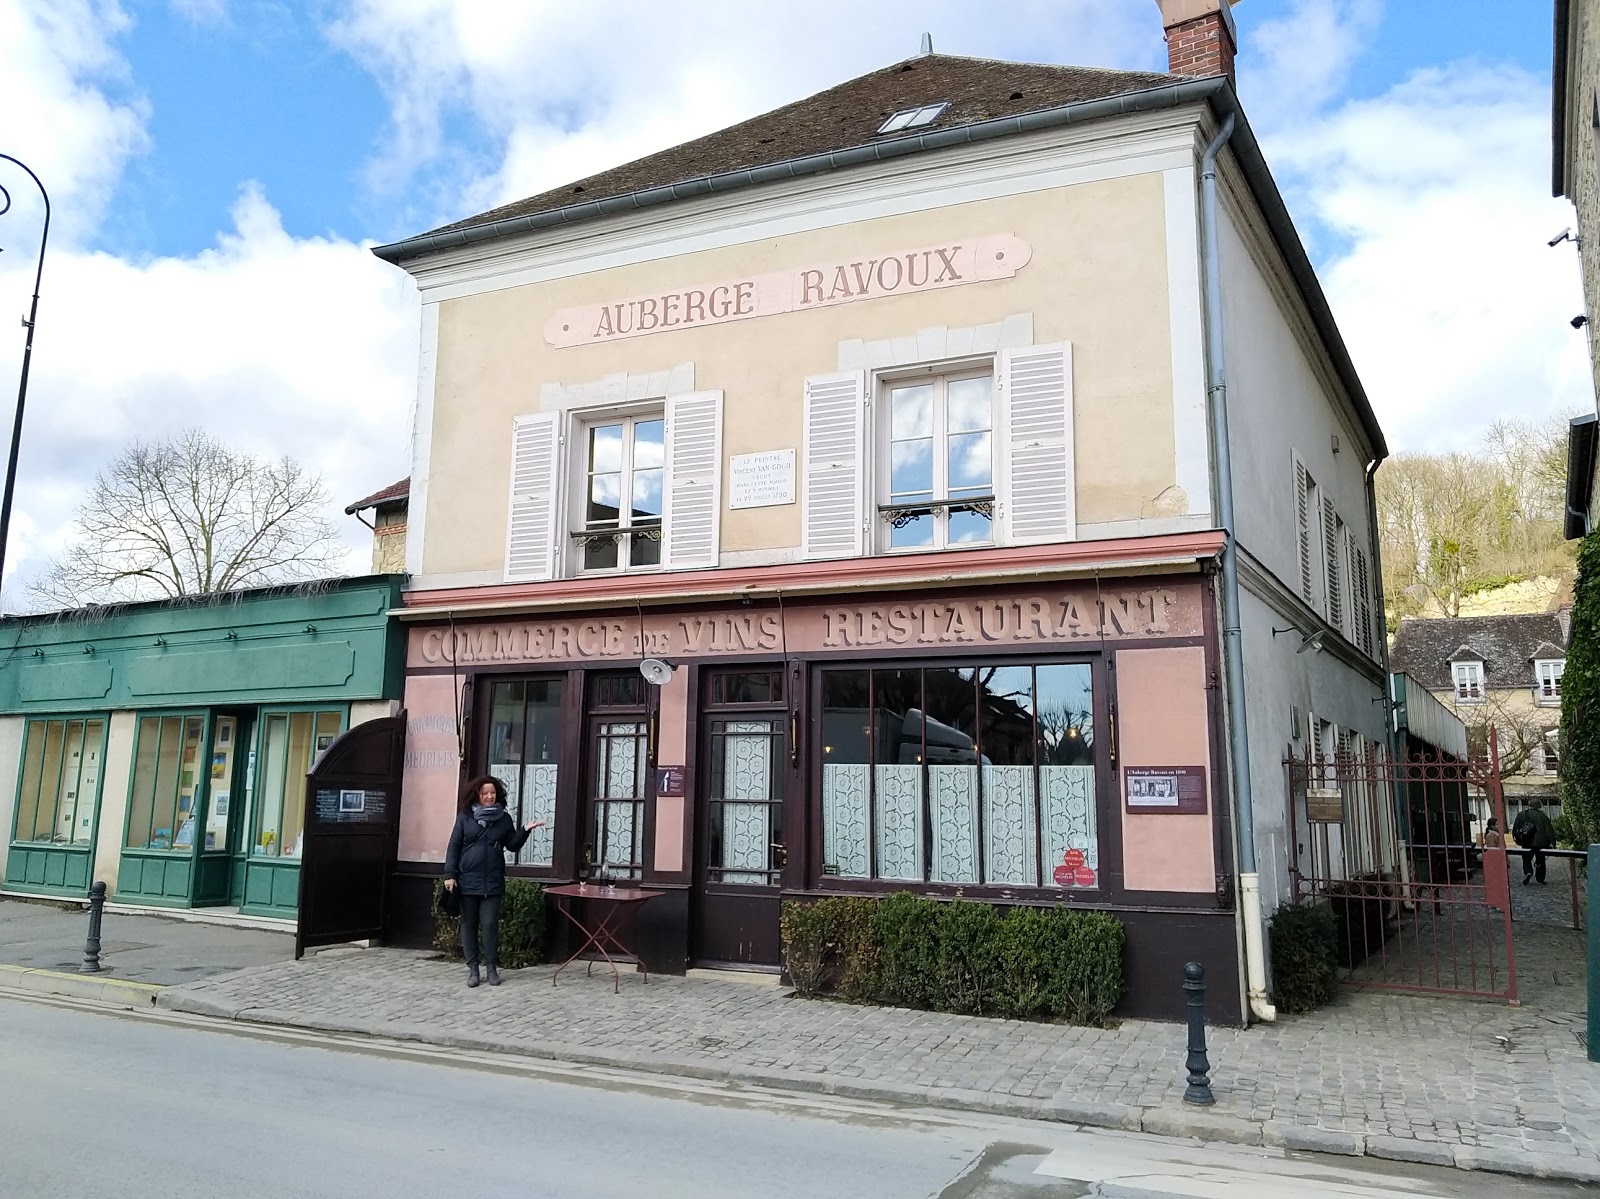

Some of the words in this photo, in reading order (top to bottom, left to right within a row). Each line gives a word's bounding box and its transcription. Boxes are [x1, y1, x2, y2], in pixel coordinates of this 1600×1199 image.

[593, 281, 754, 338] AUBERGE
[800, 246, 963, 304] RAVOUX
[754, 455, 781, 463] PEINTRE
[772, 462, 791, 471] GOGH
[421, 620, 627, 663] COMMERCE
[633, 629, 672, 656] DE
[679, 611, 784, 654] VINS
[822, 589, 1177, 648] RESTAURANT
